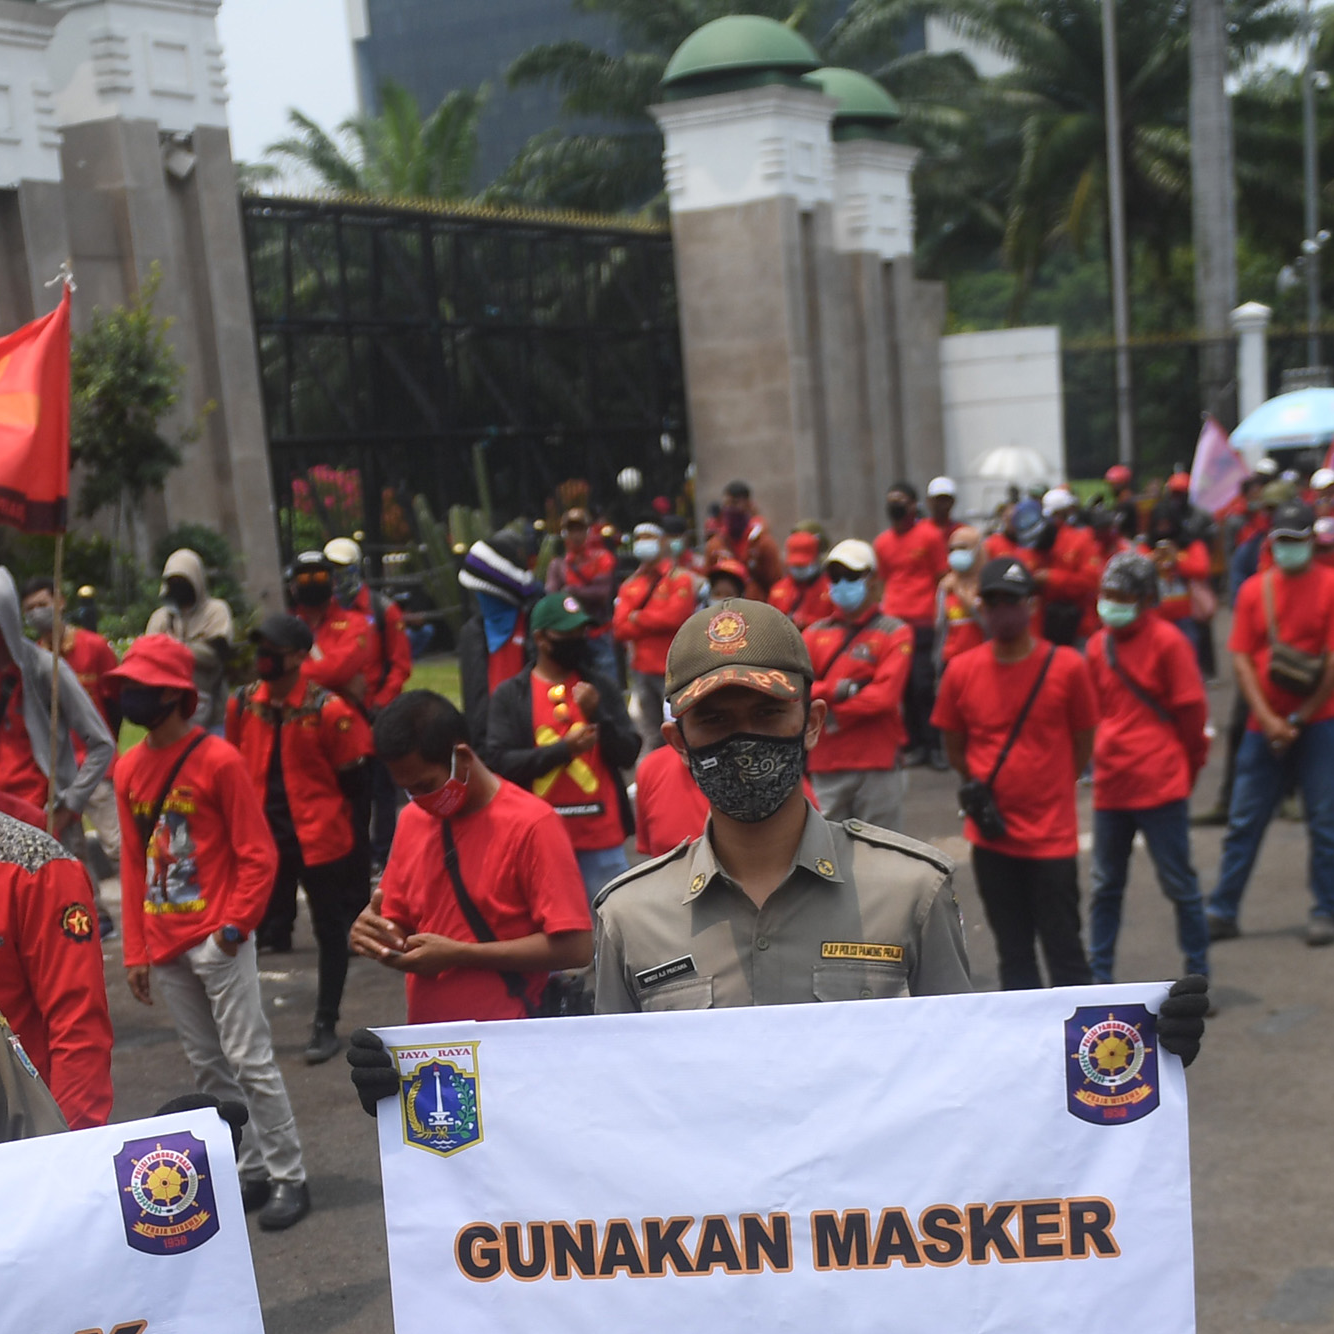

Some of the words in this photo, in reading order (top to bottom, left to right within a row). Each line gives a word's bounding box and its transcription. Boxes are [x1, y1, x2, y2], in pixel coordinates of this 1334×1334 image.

[398, 1050, 430, 1060] JAYA
[437, 1048, 471, 1058] RAYA
[147, 1151, 175, 1163] PAMONG
[174, 1154, 193, 1172] PRAJA
[163, 1235, 188, 1249] 1950
[455, 1212, 793, 1282] GUNAKAN
[812, 1196, 1120, 1271] MASKER
